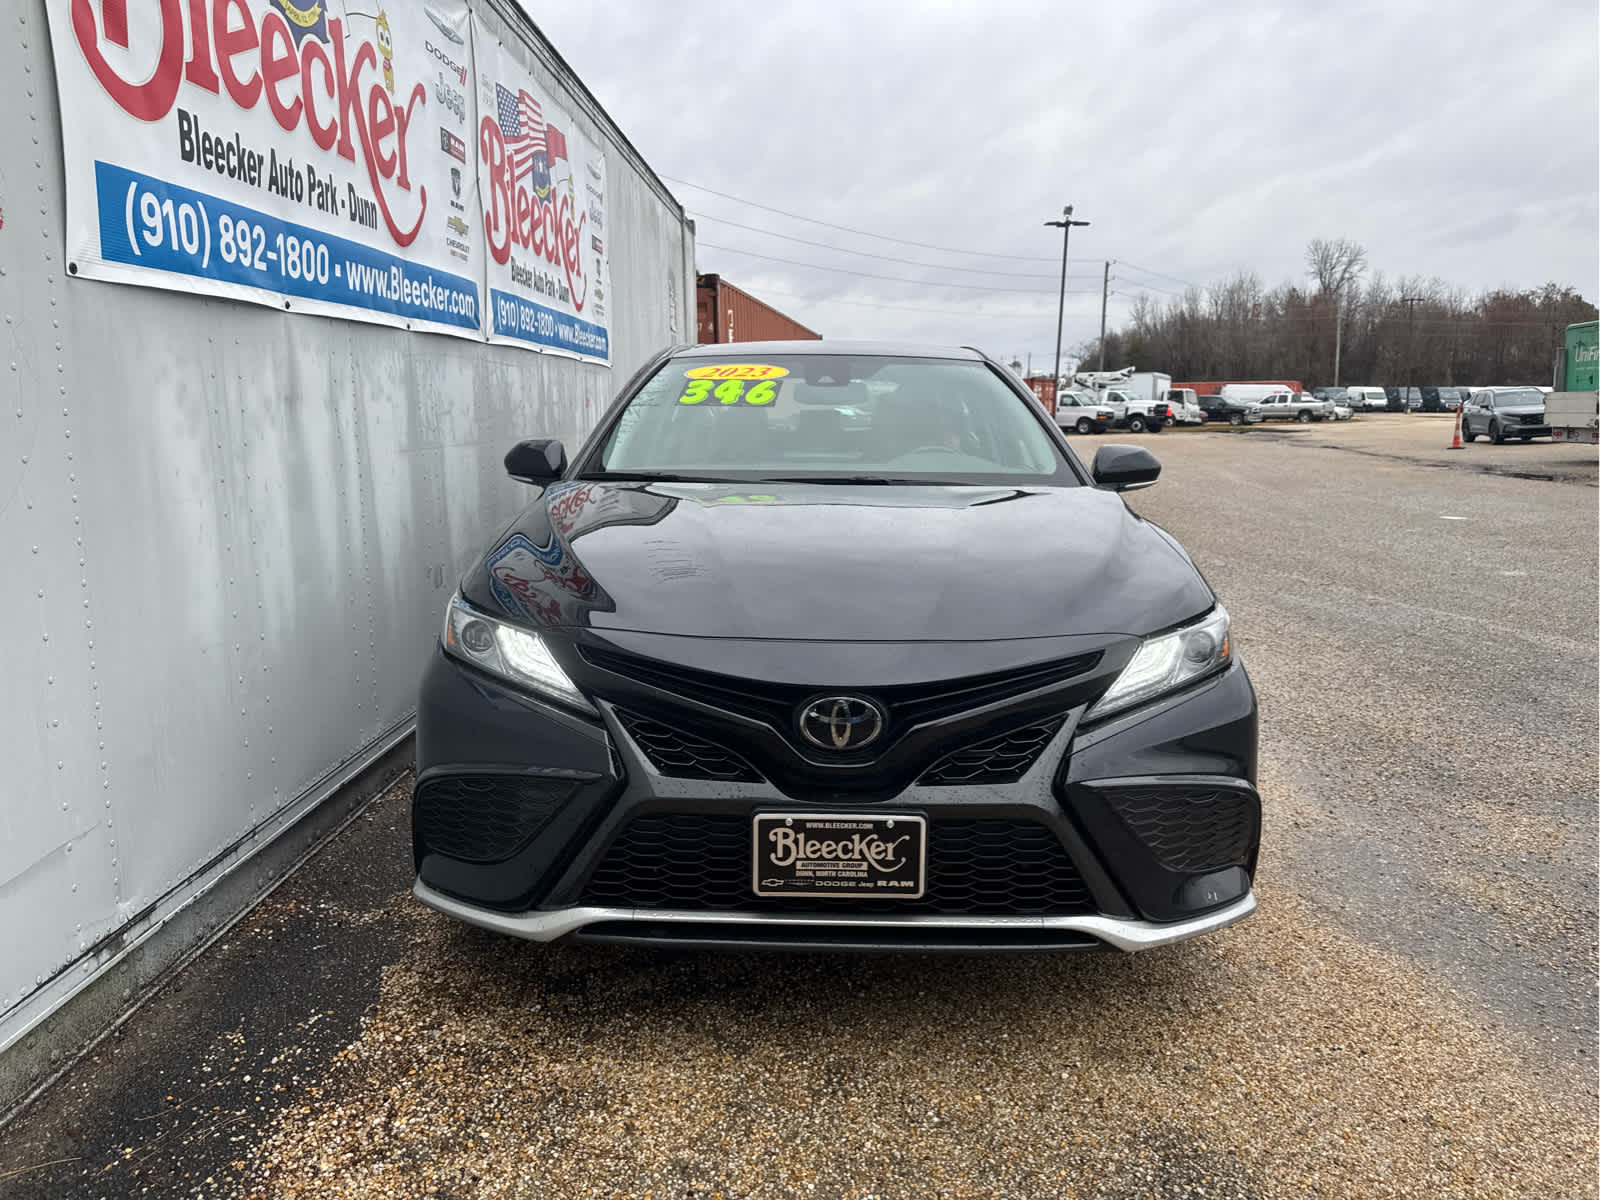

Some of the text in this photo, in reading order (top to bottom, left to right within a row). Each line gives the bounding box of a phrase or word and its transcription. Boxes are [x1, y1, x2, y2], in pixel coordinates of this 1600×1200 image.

[425, 40, 462, 77] DODGE
[177, 107, 264, 189] Bleecker
[267, 148, 304, 204] Auto
[307, 164, 340, 217] Park
[348, 182, 378, 231] Dunn
[480, 115, 587, 313] Bleecker
[126, 180, 475, 319] (910) 892-1800 www.Bleecker.com
[497, 295, 520, 334] (910)
[520, 305, 555, 338] 892-1800
[679, 379, 777, 405] 346
[700, 367, 773, 378] 2023
[768, 827, 911, 872] Bleecker
[877, 880, 915, 888] RAM
